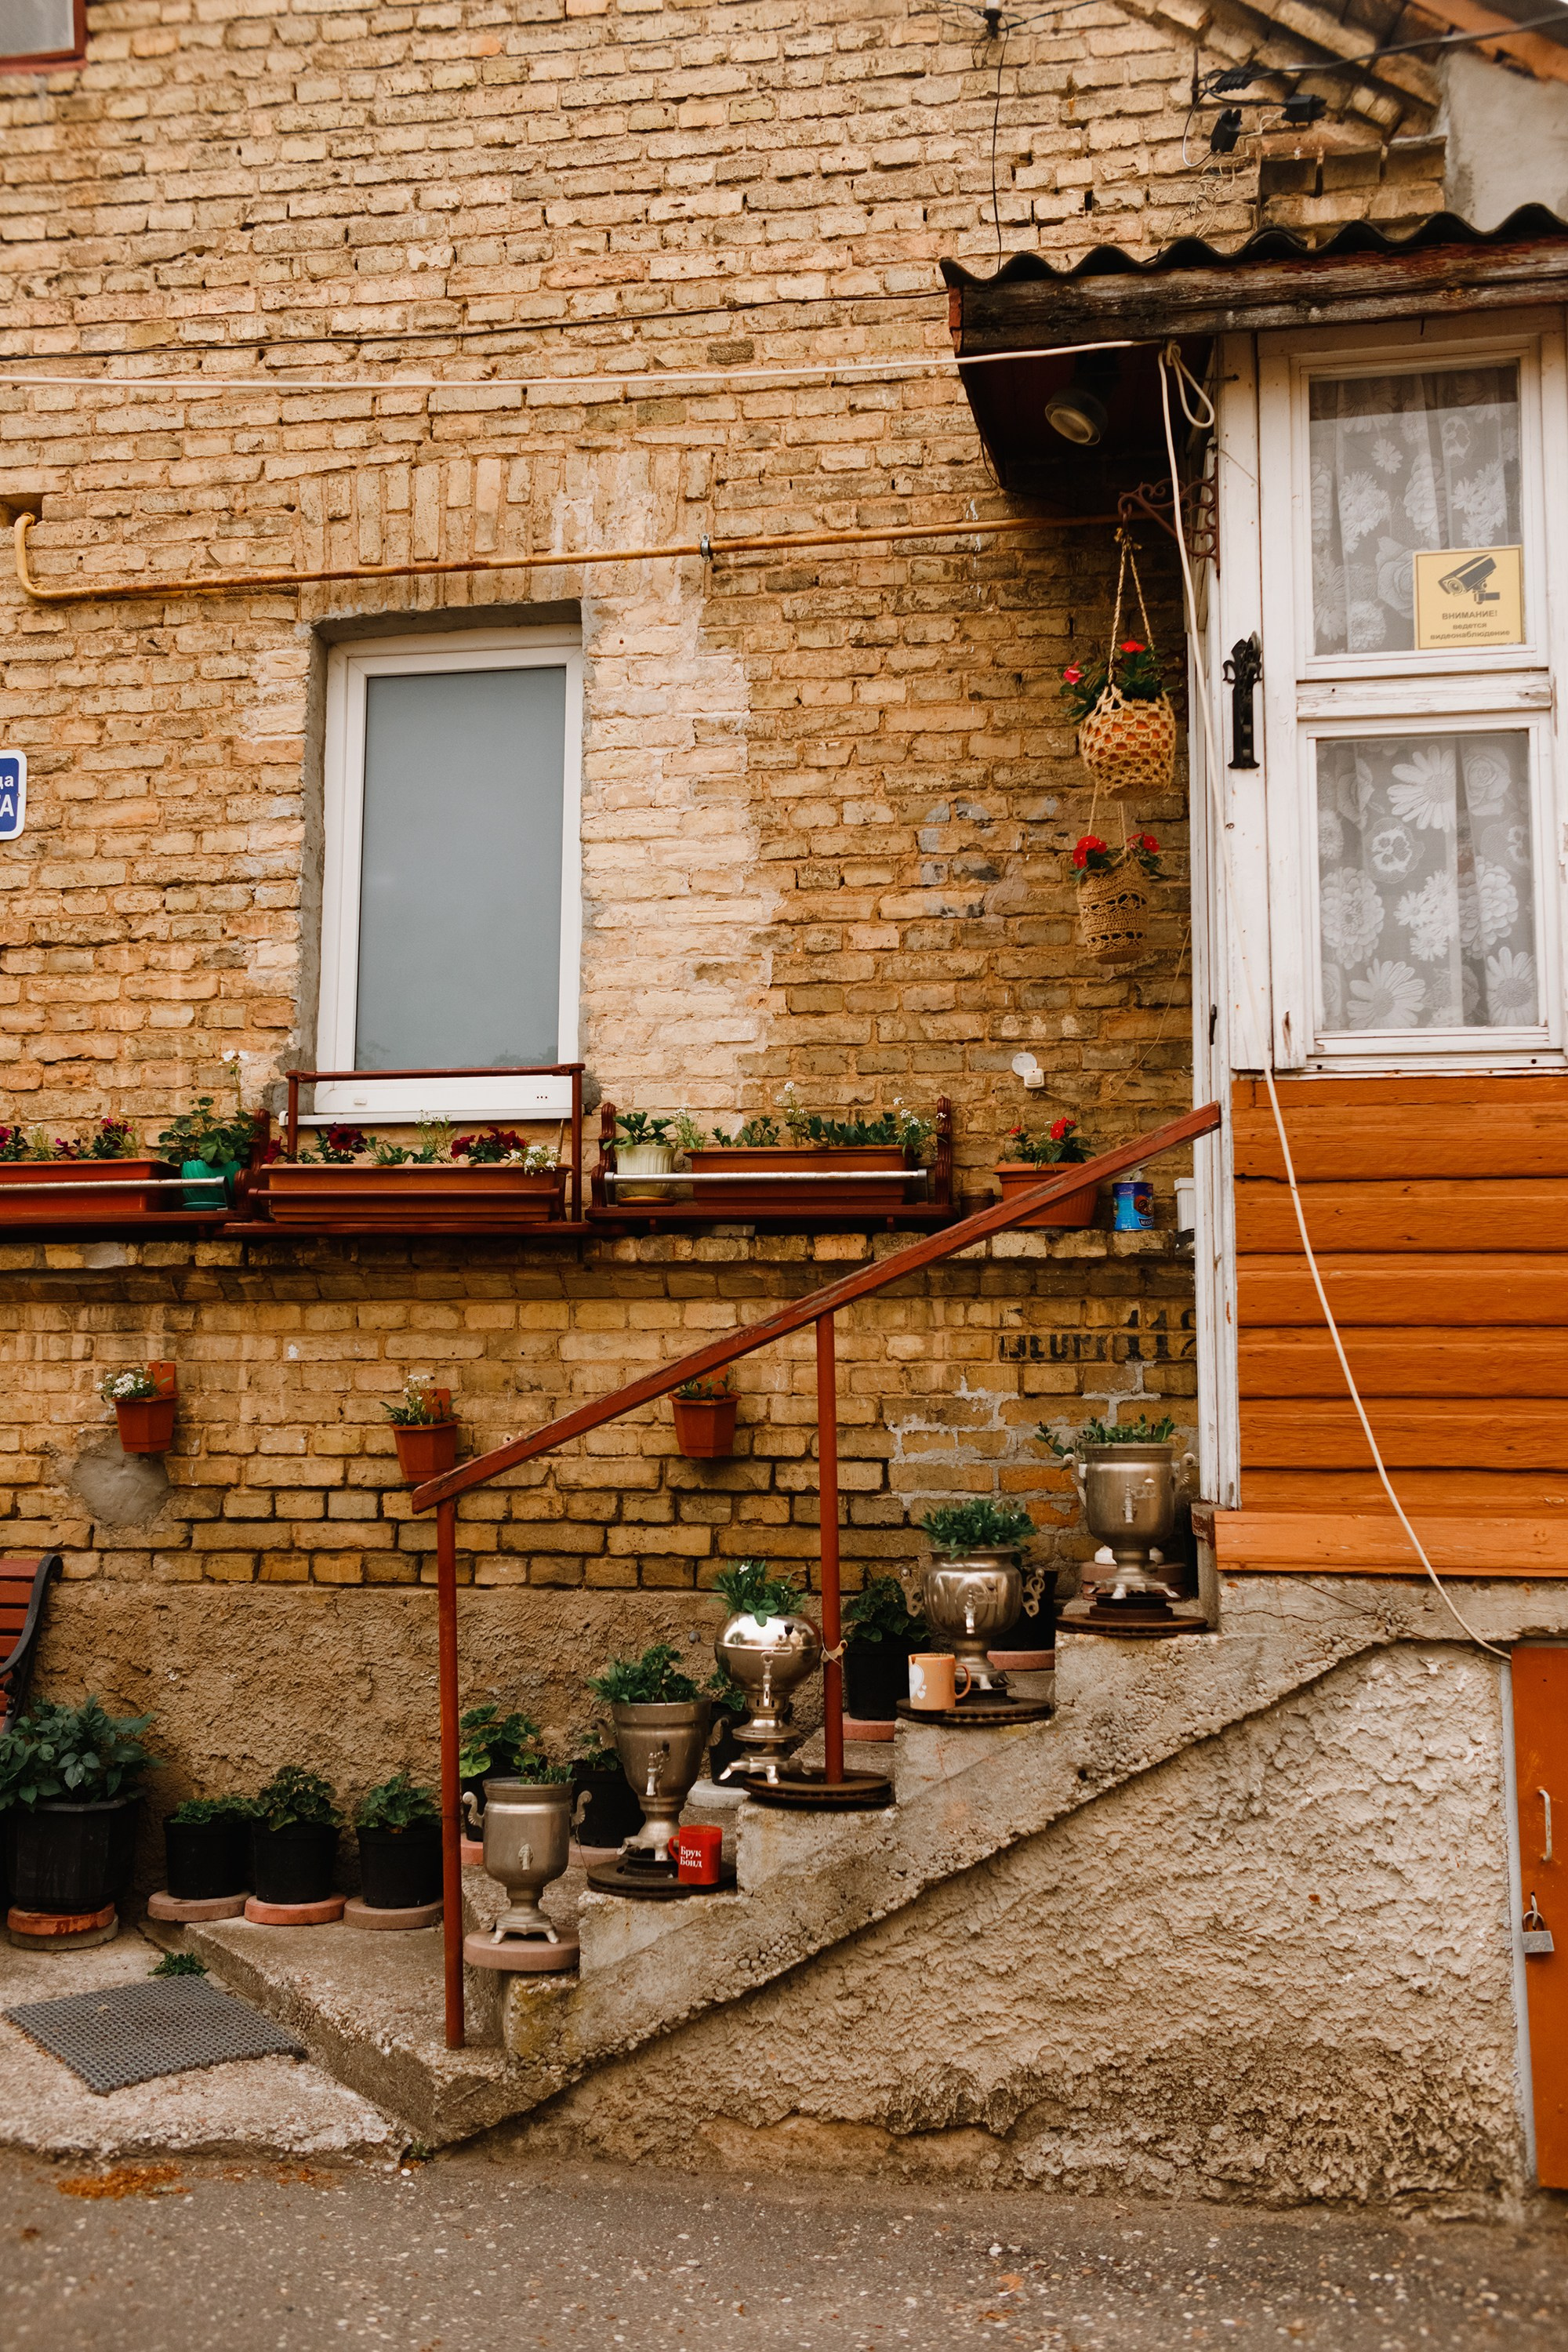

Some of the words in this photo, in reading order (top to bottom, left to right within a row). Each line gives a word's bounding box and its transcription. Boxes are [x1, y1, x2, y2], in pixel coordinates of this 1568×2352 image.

[1442, 610, 1497, 620] ВНИМАНИЕ!
[1430, 630, 1510, 640] видеонаблюдение
[681, 1846, 702, 1859] Брук
[680, 1856, 702, 1868] Бонд
